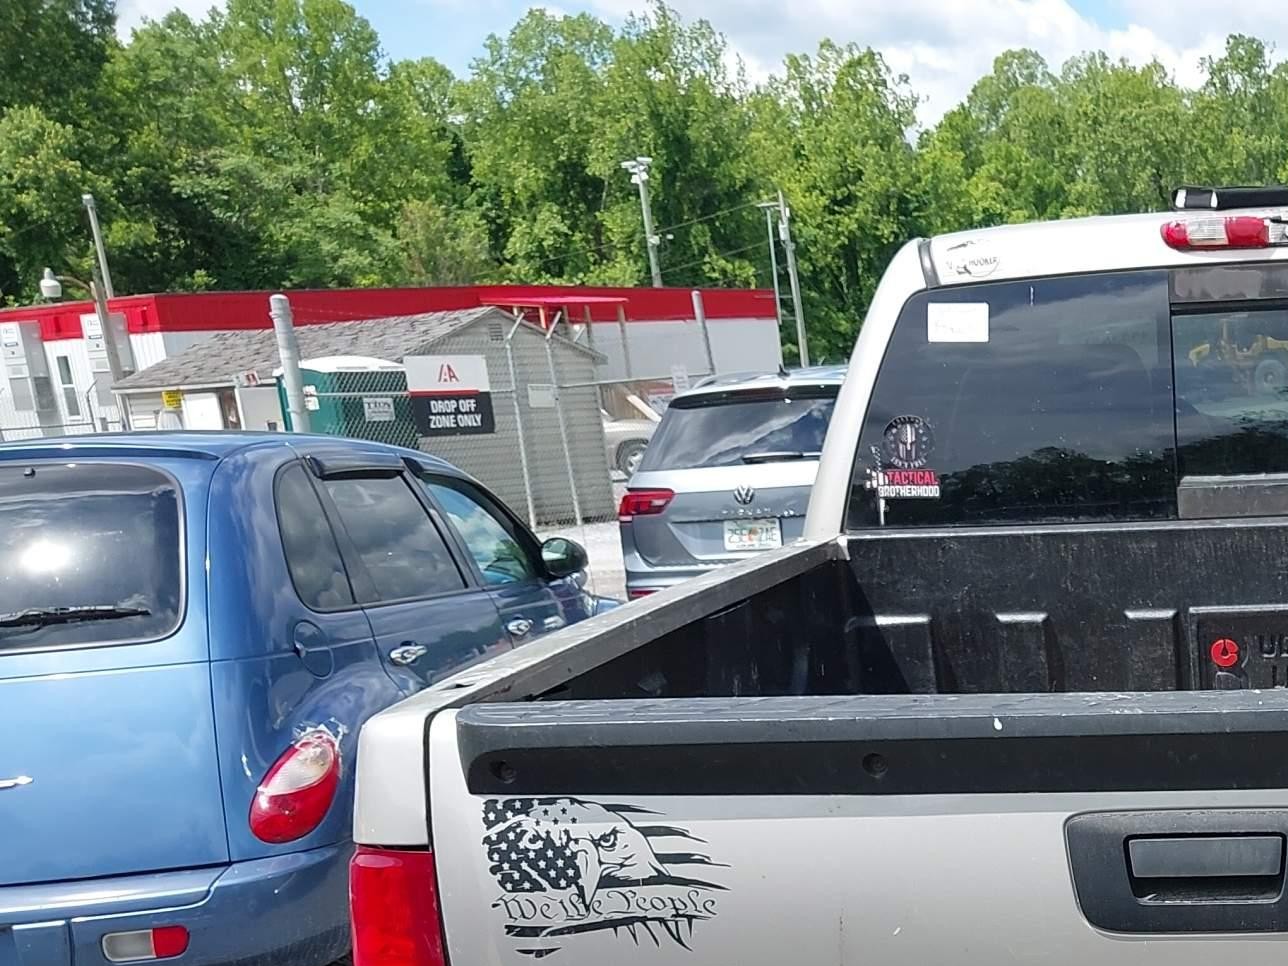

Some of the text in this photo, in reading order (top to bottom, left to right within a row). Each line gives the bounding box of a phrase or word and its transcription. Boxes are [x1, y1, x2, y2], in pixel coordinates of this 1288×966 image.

[430, 399, 477, 413] DROP OFF
[428, 414, 482, 428] ZONE ONLY
[886, 471, 939, 485] TACTICAL
[878, 485, 940, 497] BROTHERHOOD
[498, 894, 559, 922] We
[604, 889, 718, 918] People
